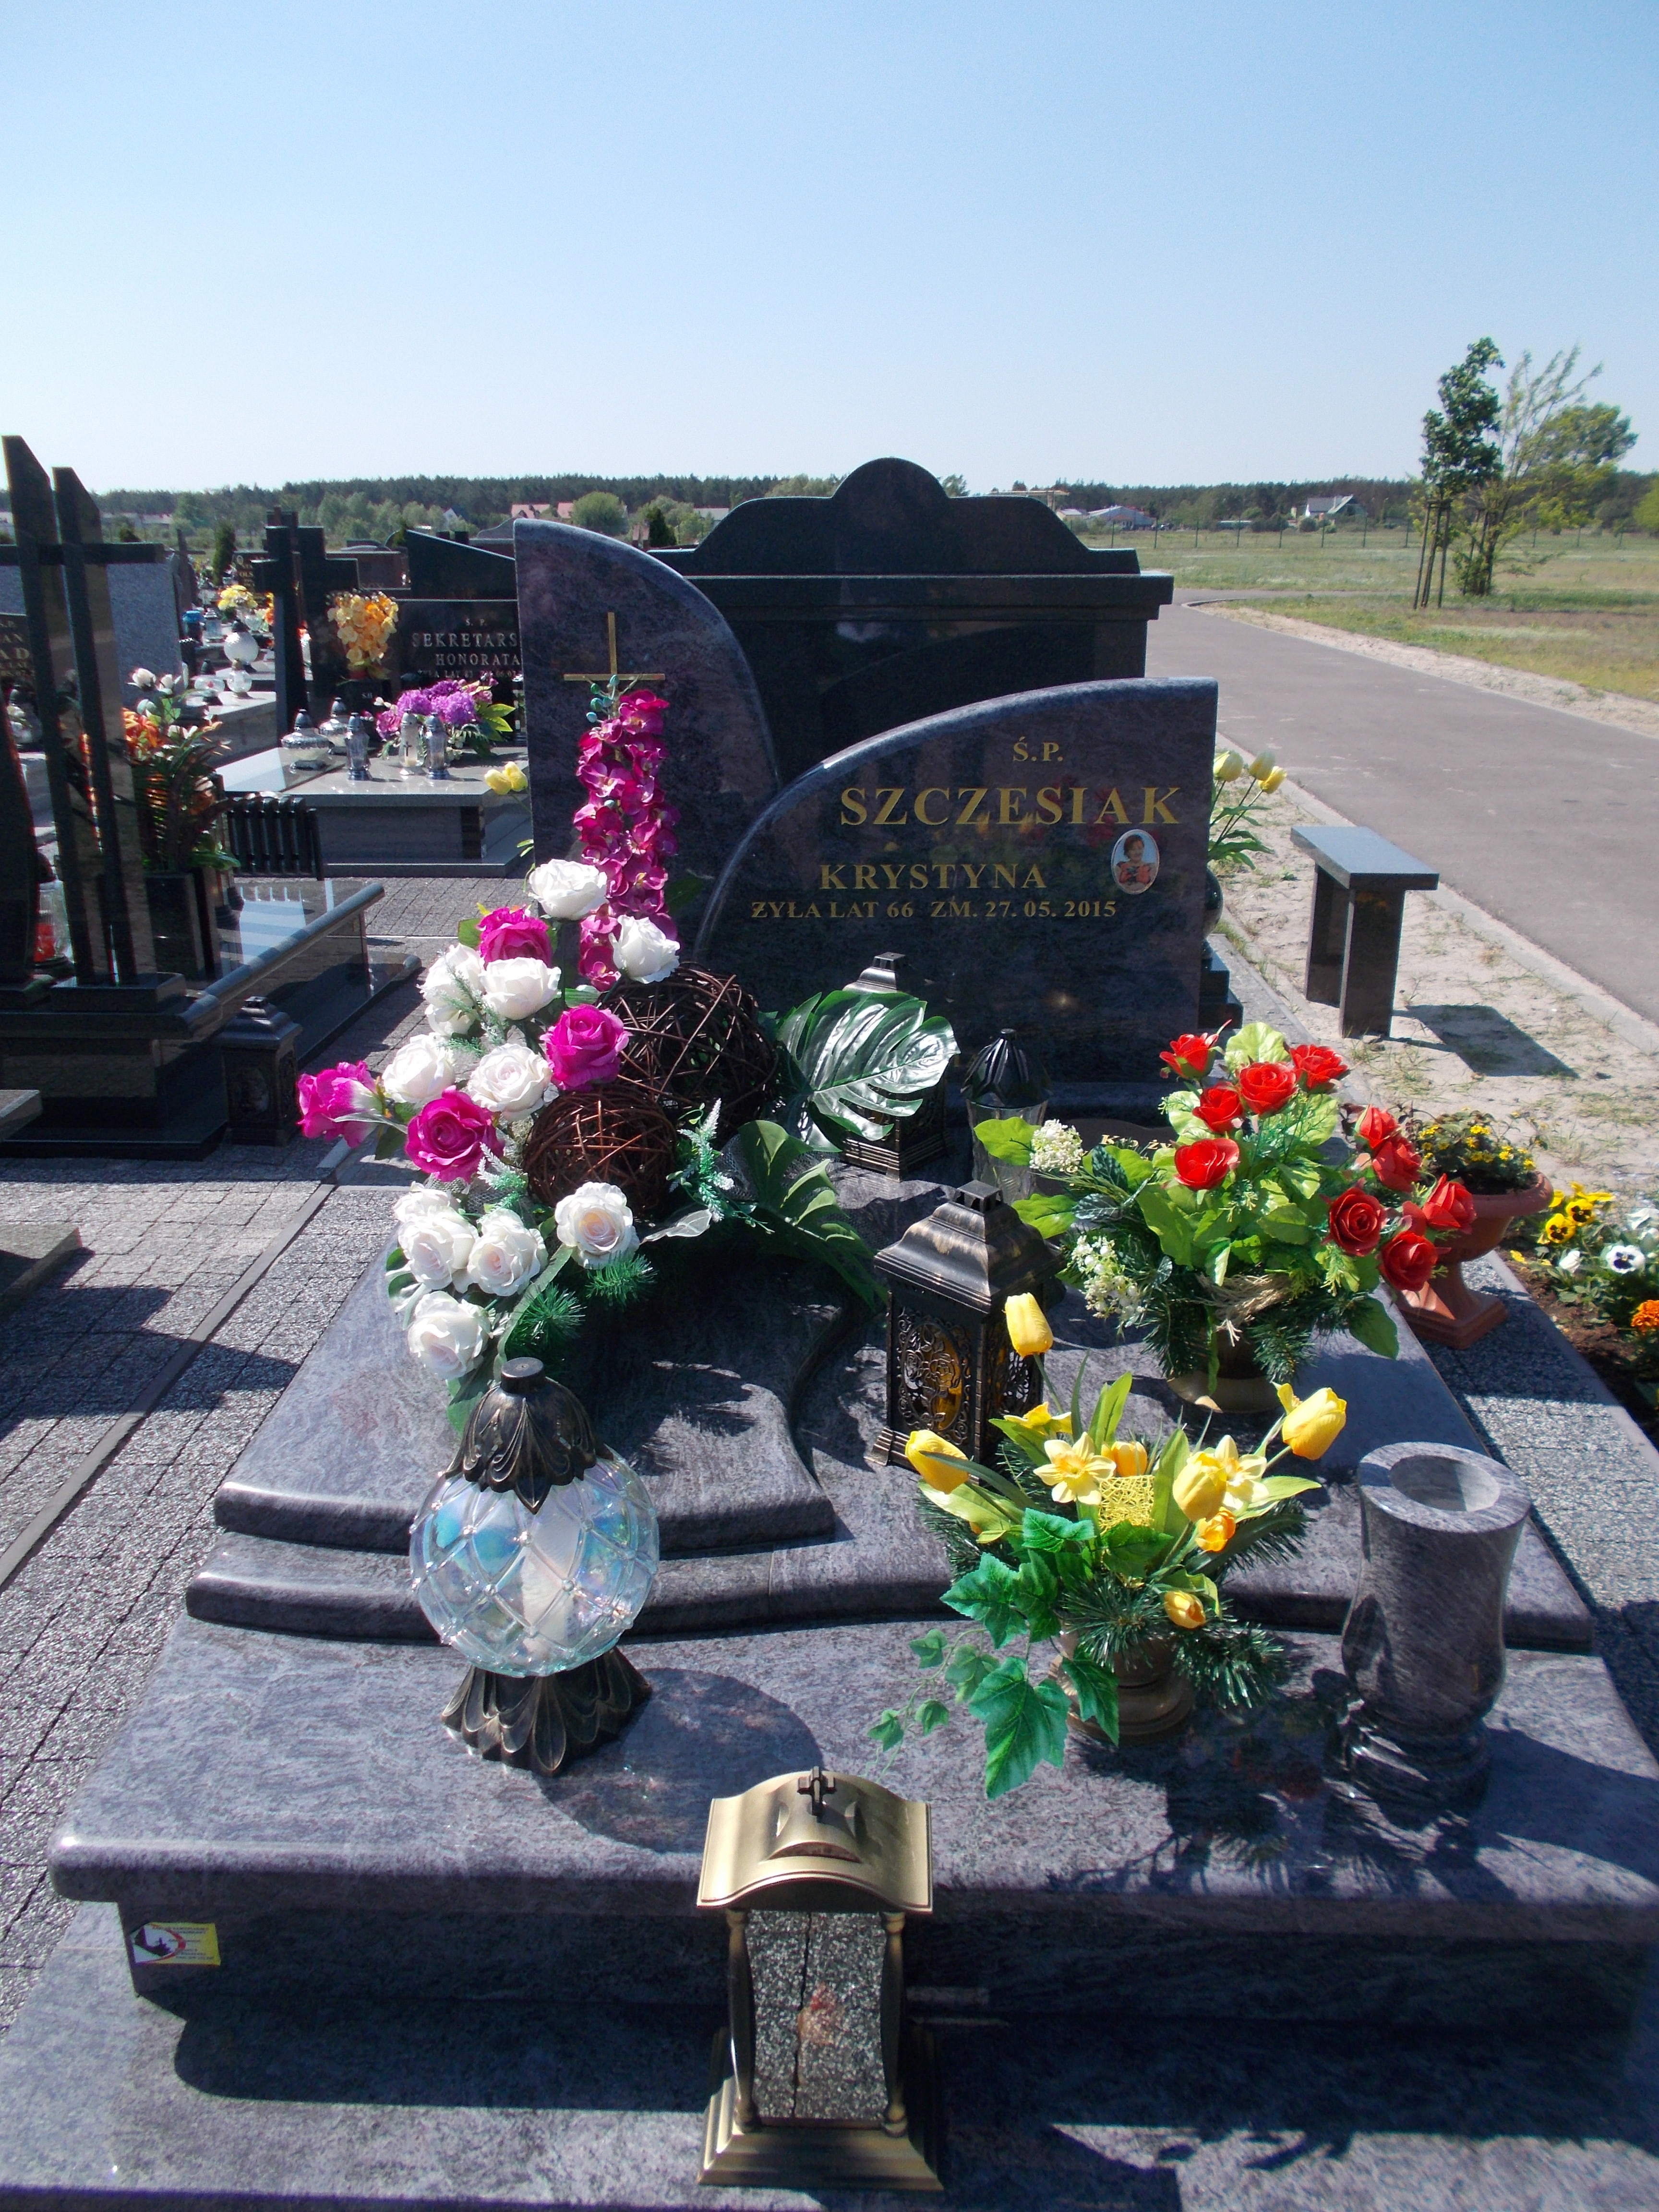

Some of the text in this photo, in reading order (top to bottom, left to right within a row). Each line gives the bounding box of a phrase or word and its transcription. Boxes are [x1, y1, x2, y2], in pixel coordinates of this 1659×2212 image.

[435, 653, 520, 666] HONORATA
[840, 787, 1181, 825] SZCZESIAK
[819, 864, 1047, 890] KRYSTYNA
[830, 901, 879, 917] LAT
[887, 901, 914, 917] 66
[930, 901, 978, 918] ZM.
[1064, 900, 1117, 917] 2015
